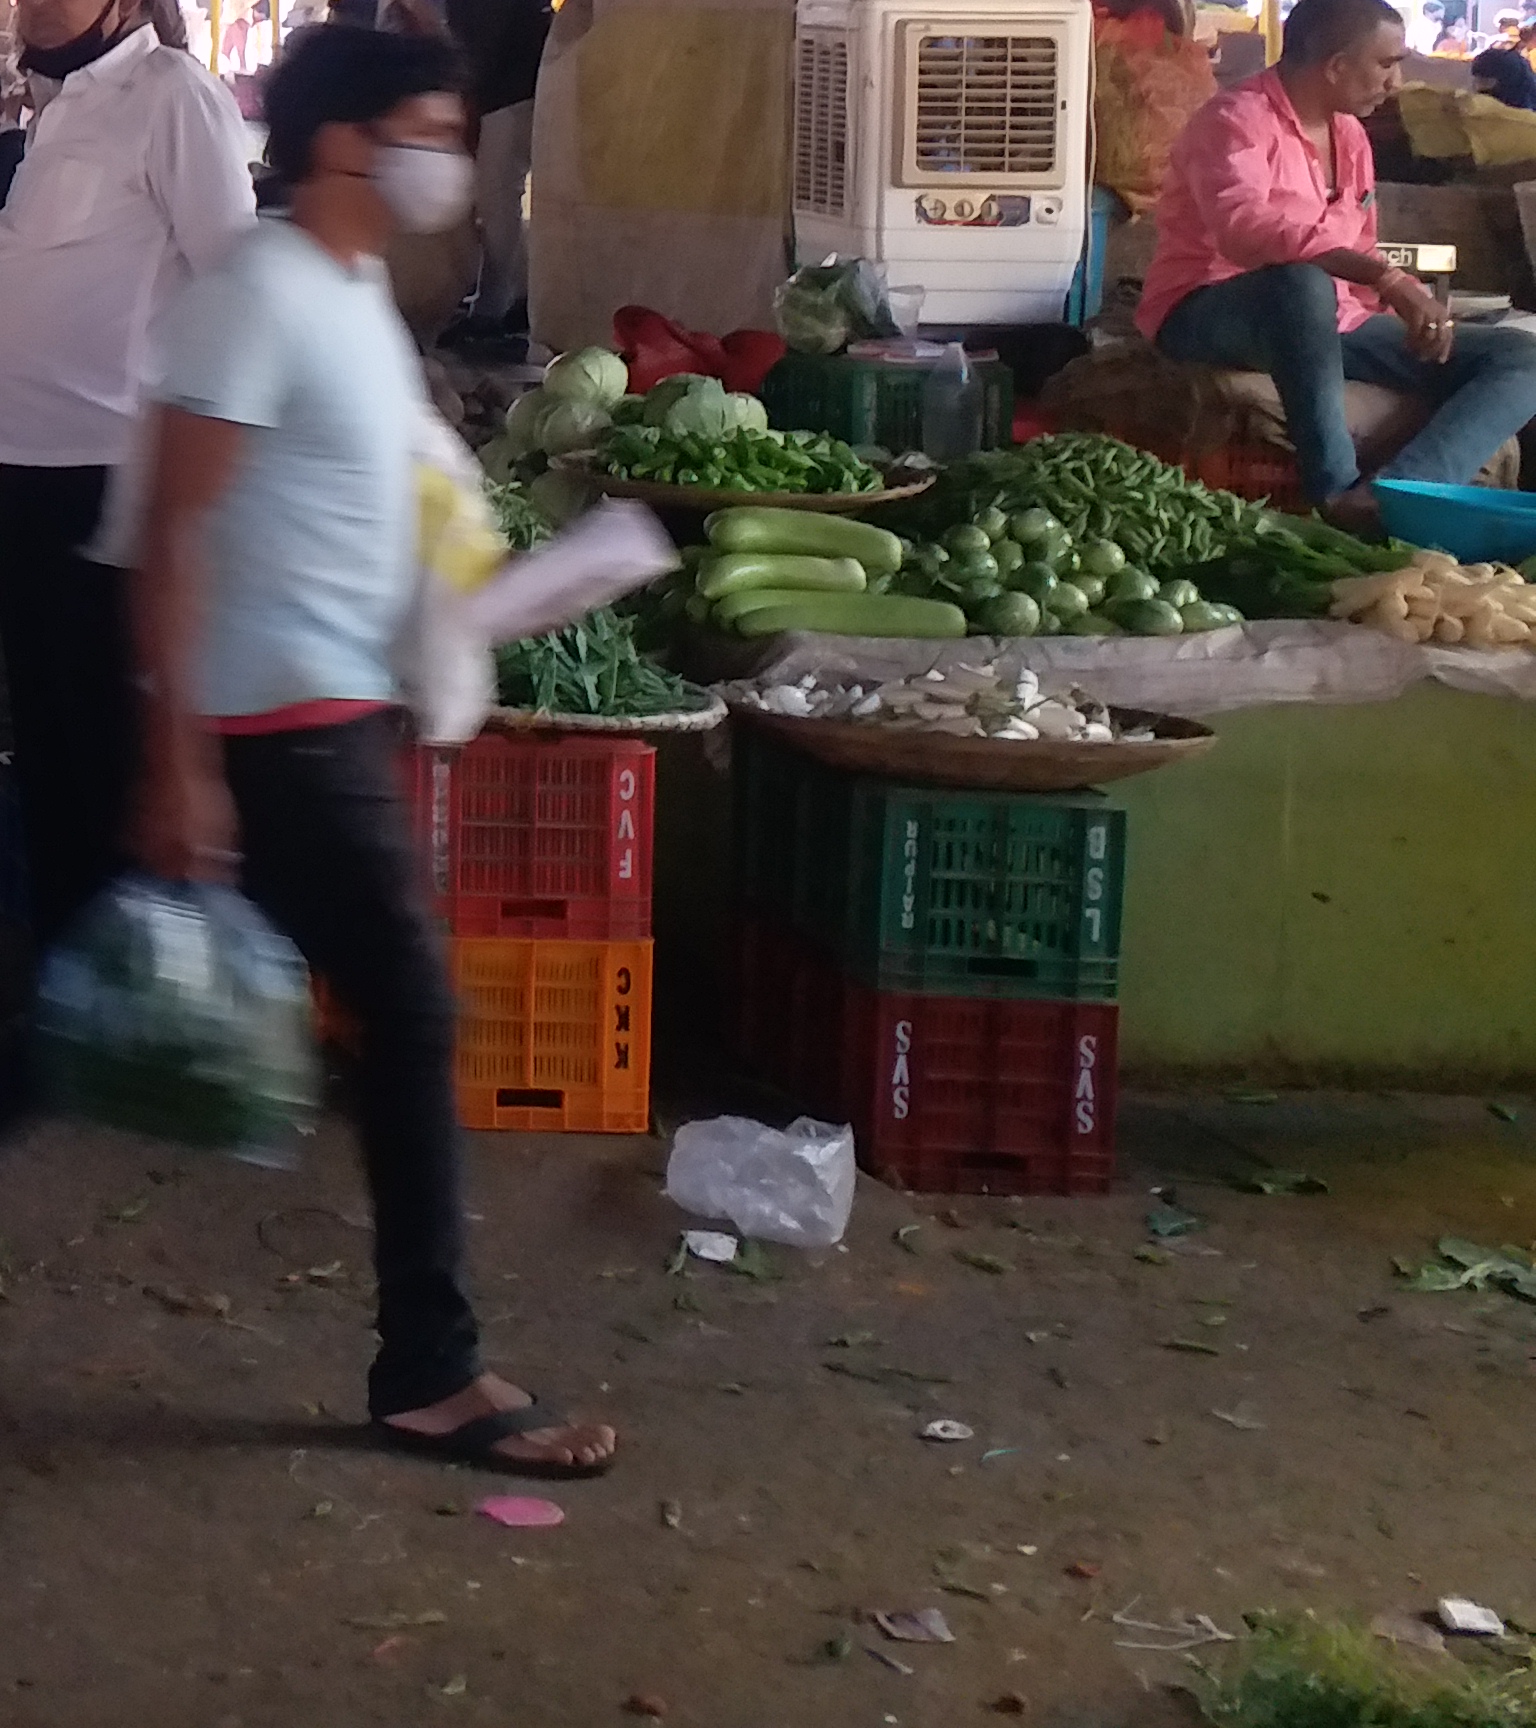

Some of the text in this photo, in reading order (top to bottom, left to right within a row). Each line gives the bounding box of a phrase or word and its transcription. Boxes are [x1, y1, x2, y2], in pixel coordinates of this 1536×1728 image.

[616, 769, 636, 880] FVC
[892, 1020, 913, 1120] SAS
[1075, 1035, 1096, 1135] SAS
